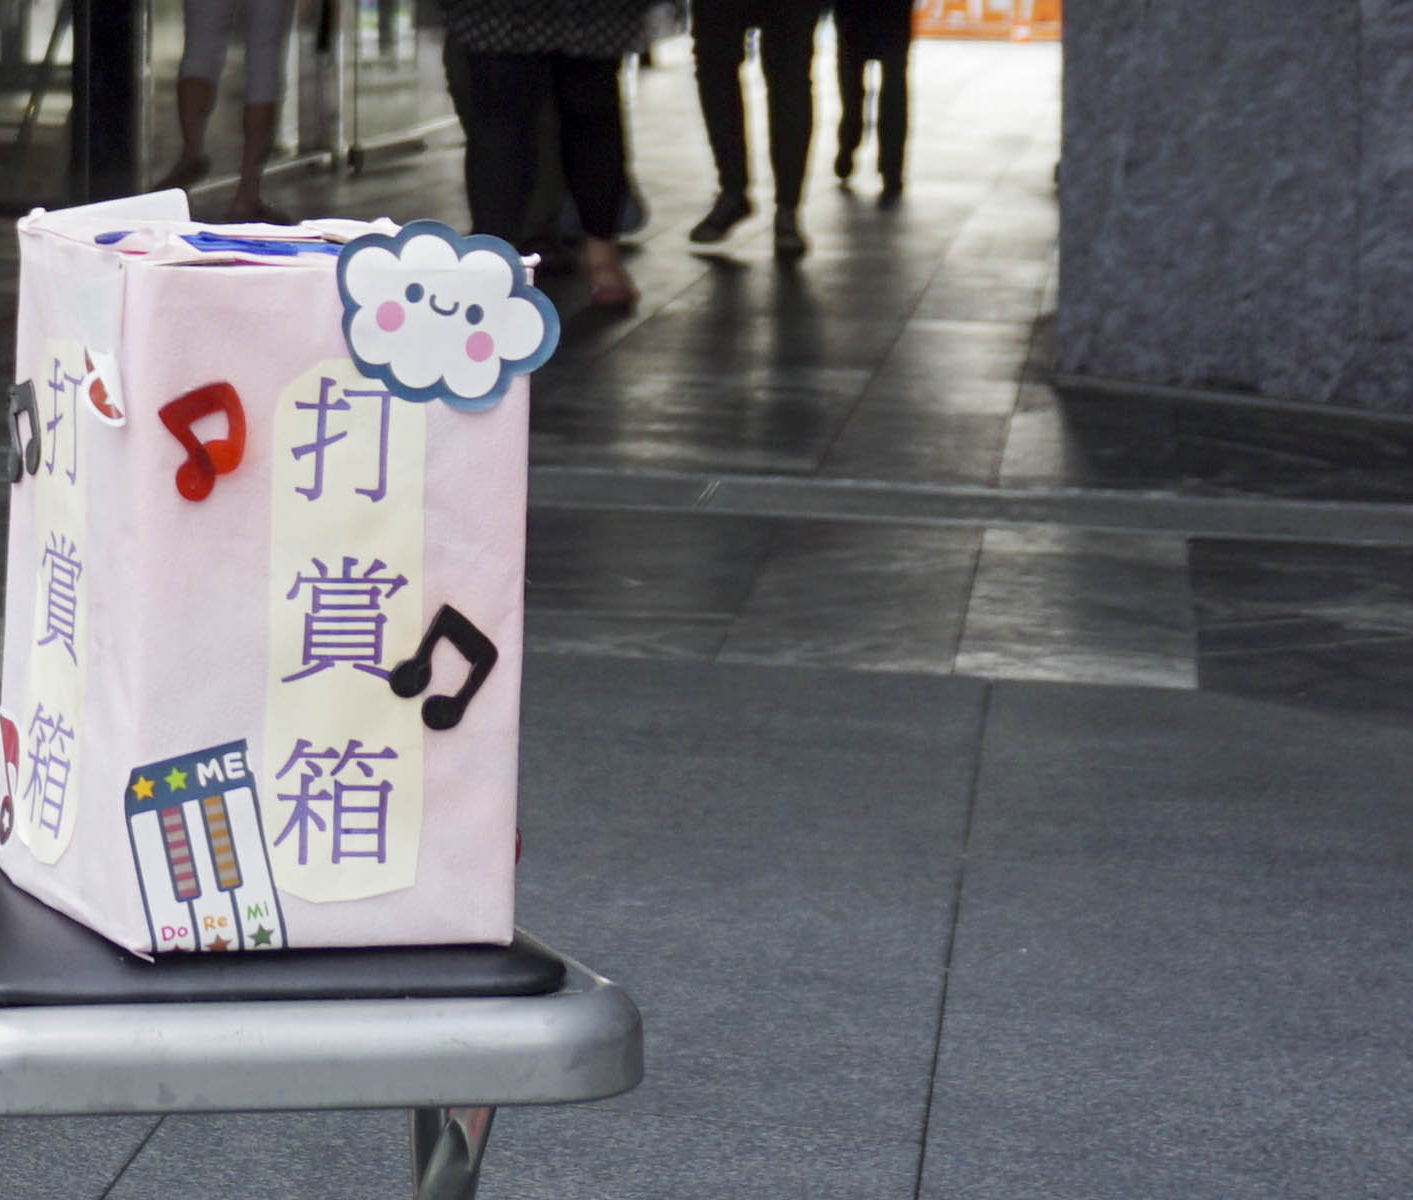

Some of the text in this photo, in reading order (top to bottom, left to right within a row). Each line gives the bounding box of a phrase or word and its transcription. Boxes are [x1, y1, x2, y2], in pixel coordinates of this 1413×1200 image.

[22, 357, 84, 841] 打賞箱
[272, 377, 409, 866] 打賞箱
[161, 901, 269, 941] Do Re Mi
